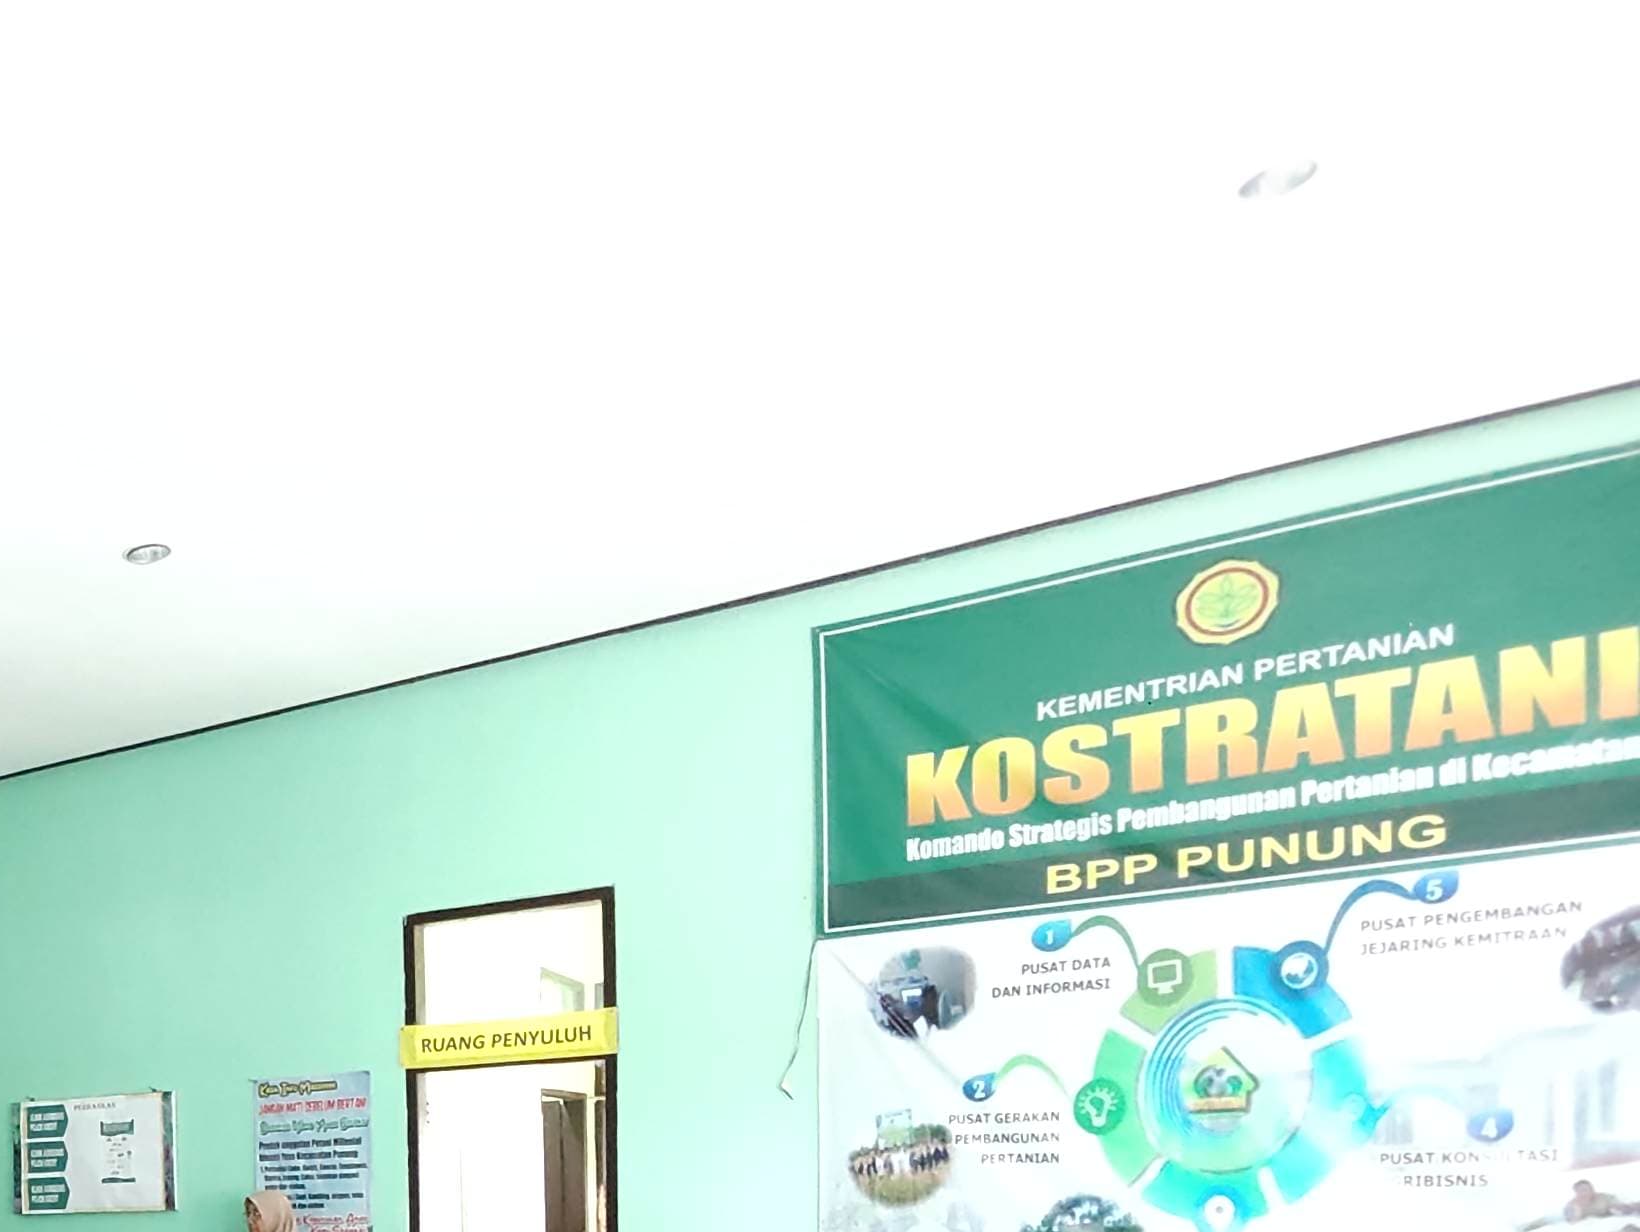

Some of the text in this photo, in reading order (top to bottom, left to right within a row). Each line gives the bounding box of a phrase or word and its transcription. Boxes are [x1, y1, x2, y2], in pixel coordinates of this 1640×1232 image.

[1036, 624, 1455, 721] KEMENTRIAN PERTANIAN
[906, 626, 1639, 827] KOSTRATANI
[906, 828, 1005, 862] Komando
[1009, 812, 1113, 848] Strategis
[1117, 786, 1297, 833] Pembangunan
[1301, 765, 1435, 806] Pertanian
[1439, 756, 1467, 786] di
[1046, 814, 1447, 895] BPP PUNUNG
[1426, 879, 1443, 901] 5
[1360, 900, 1583, 932] PUSAT PENGEMBANGAN
[1044, 928, 1054, 945] 1
[1361, 926, 1567, 956] JEJARING KEMITRAAN
[1020, 956, 1111, 976] PUSAT DATA
[991, 977, 1111, 998] DAN INFORMASI
[421, 1025, 592, 1053] RUANG PENYULUH
[972, 1080, 986, 1099] 2
[948, 1111, 1060, 1125] PUSAT GERAKAN
[1480, 1117, 1499, 1139] 4
[954, 1132, 1060, 1145] PEMBANGUNAN
[980, 1152, 1060, 1164] PERTANIAN
[1380, 1149, 1558, 1165] PUSAT KONTASI
